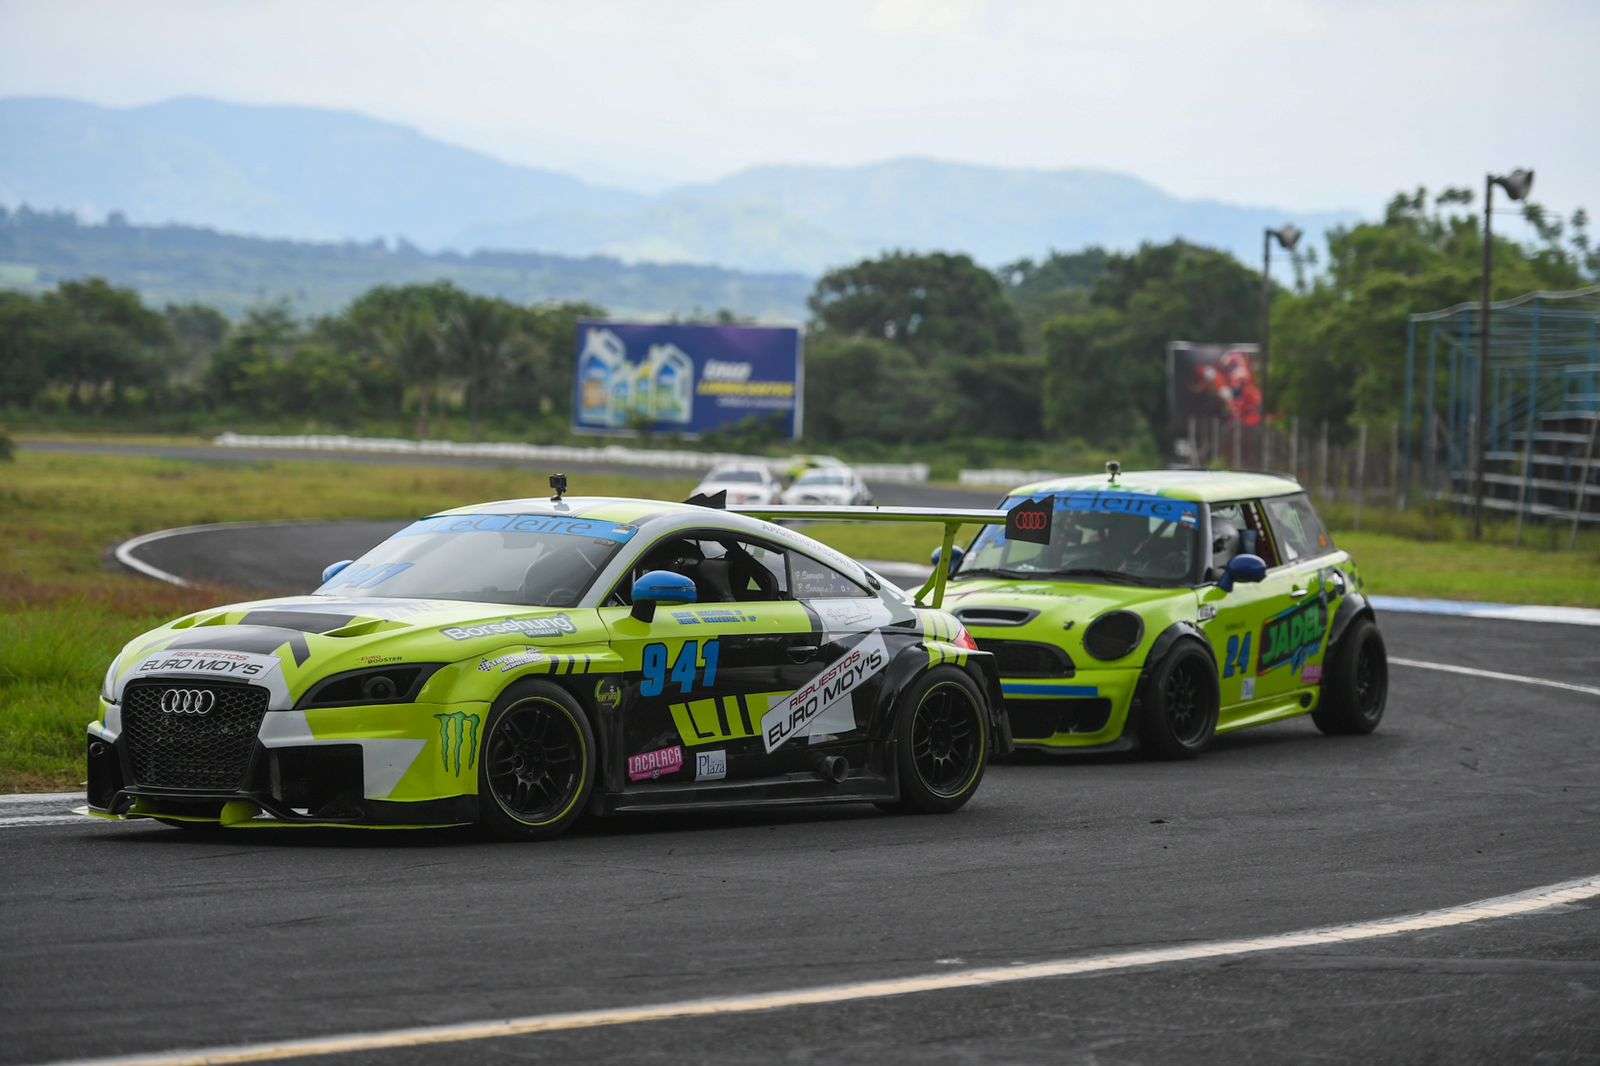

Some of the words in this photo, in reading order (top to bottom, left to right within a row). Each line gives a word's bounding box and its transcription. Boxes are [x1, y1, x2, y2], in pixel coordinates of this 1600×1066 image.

[444, 614, 573, 640] Borsehung
[140, 659, 191, 672] EURO
[194, 659, 264, 675] MOY'S
[639, 637, 722, 697] 941
[1223, 631, 1252, 678] 24
[768, 696, 818, 747] EURO
[823, 648, 882, 705] MOY'S
[789, 650, 861, 710] REPUESTOS
[629, 747, 682, 774] LACALACA
[698, 756, 726, 776] Plaza
